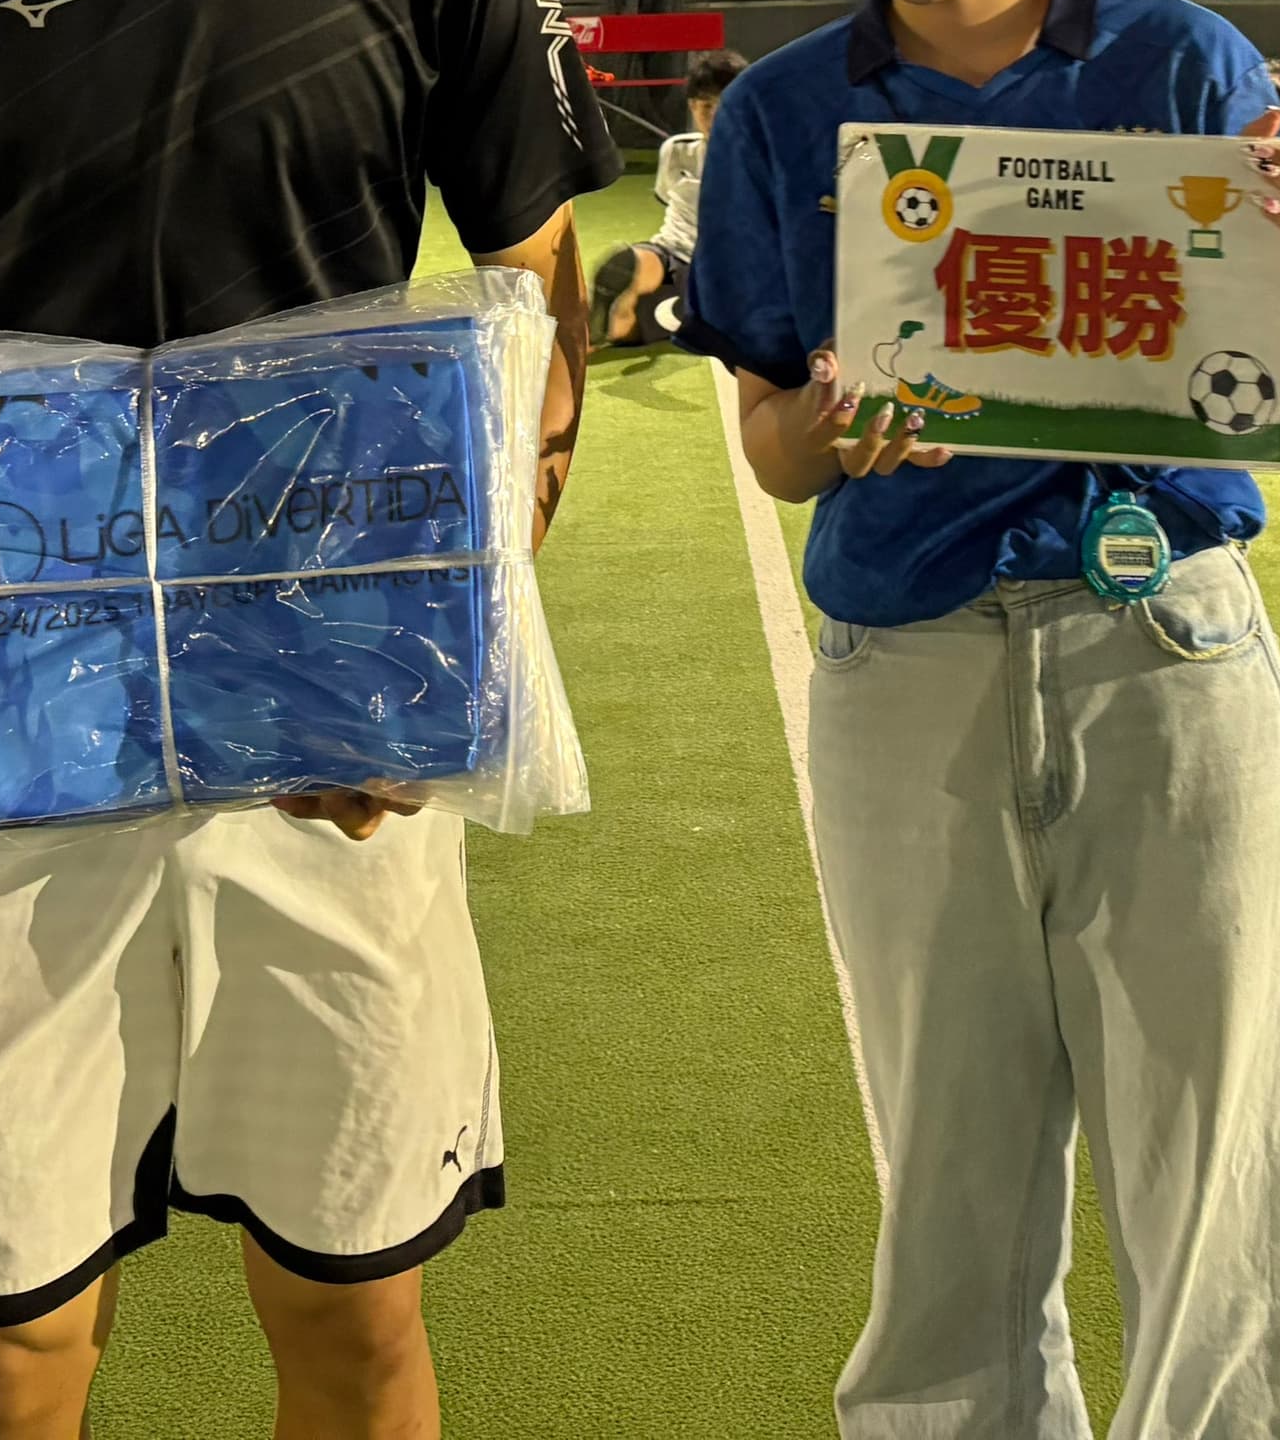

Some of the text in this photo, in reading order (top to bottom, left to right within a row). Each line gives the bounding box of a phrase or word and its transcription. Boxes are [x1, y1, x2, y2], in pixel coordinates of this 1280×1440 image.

[998, 156, 1115, 182] FOOTBALL
[1026, 187, 1085, 211] GAME
[933, 228, 1187, 361] 優勝
